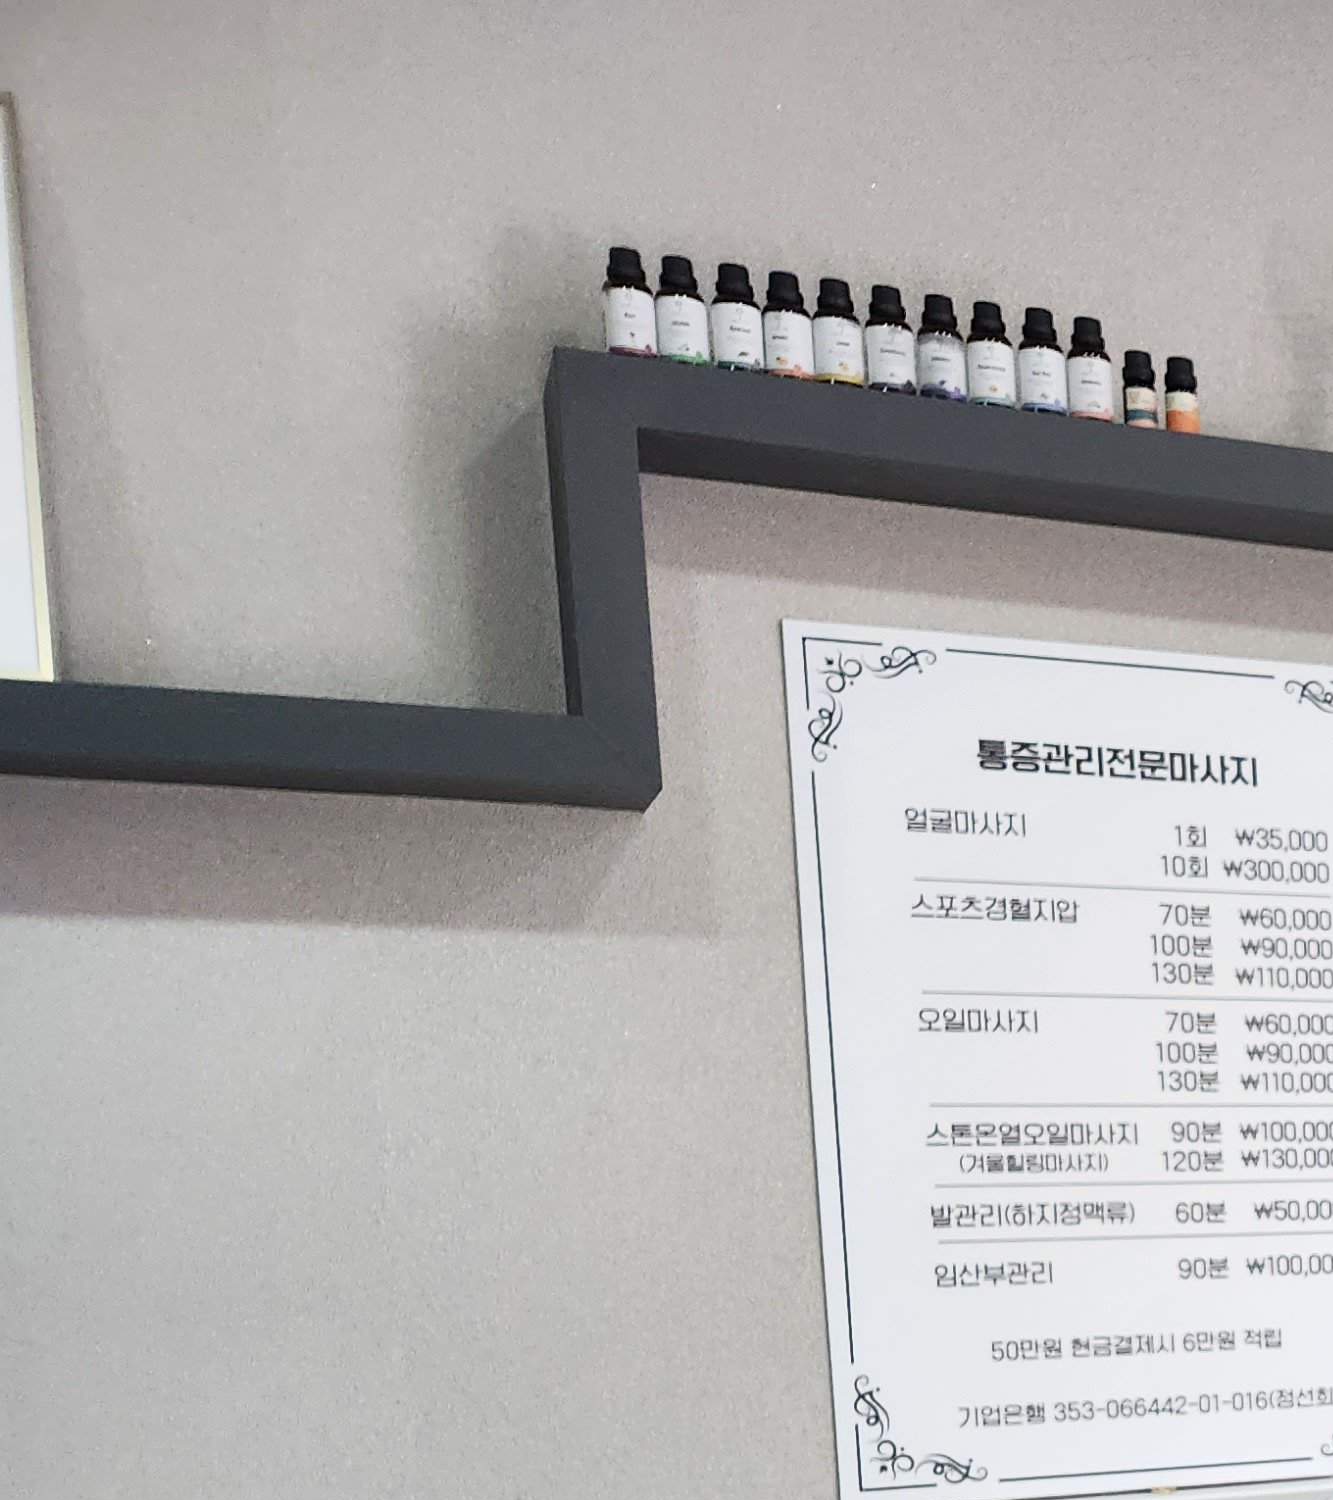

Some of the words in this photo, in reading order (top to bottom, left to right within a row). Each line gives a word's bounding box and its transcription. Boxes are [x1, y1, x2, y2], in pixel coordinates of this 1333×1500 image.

[975, 738, 1259, 788] 통증관리전문마사지
[904, 807, 1027, 838] 얼굴마사지
[1174, 824, 1207, 849] 1회
[1234, 826, 1329, 853] ₩35,000
[1160, 854, 1209, 879] 10회
[1222, 858, 1330, 885] ₩300,000
[910, 893, 1081, 924] 스포츠경혈지압
[1158, 902, 1212, 928] 70분
[1238, 907, 1333, 932] ₩60,000
[1149, 933, 1213, 959] 100분
[1239, 936, 1333, 962] ₩90,000
[1151, 961, 1215, 986] 130분
[918, 1007, 1039, 1034] 오일마사지
[1165, 1010, 1217, 1035] 70분
[1155, 1041, 1219, 1065] 100분
[1157, 1069, 1221, 1094] 130분
[1170, 1120, 1223, 1144] 90분
[1161, 1149, 1225, 1173] 120분
[1174, 1200, 1227, 1225] 60분
[933, 1260, 1054, 1289] 임산부관리
[1177, 1256, 1230, 1281] 90분
[991, 1337, 1063, 1363] 50만원
[1182, 1330, 1236, 1353] 6만원
[1243, 1328, 1283, 1349] 적립
[958, 1402, 1047, 1429] 기업은행
